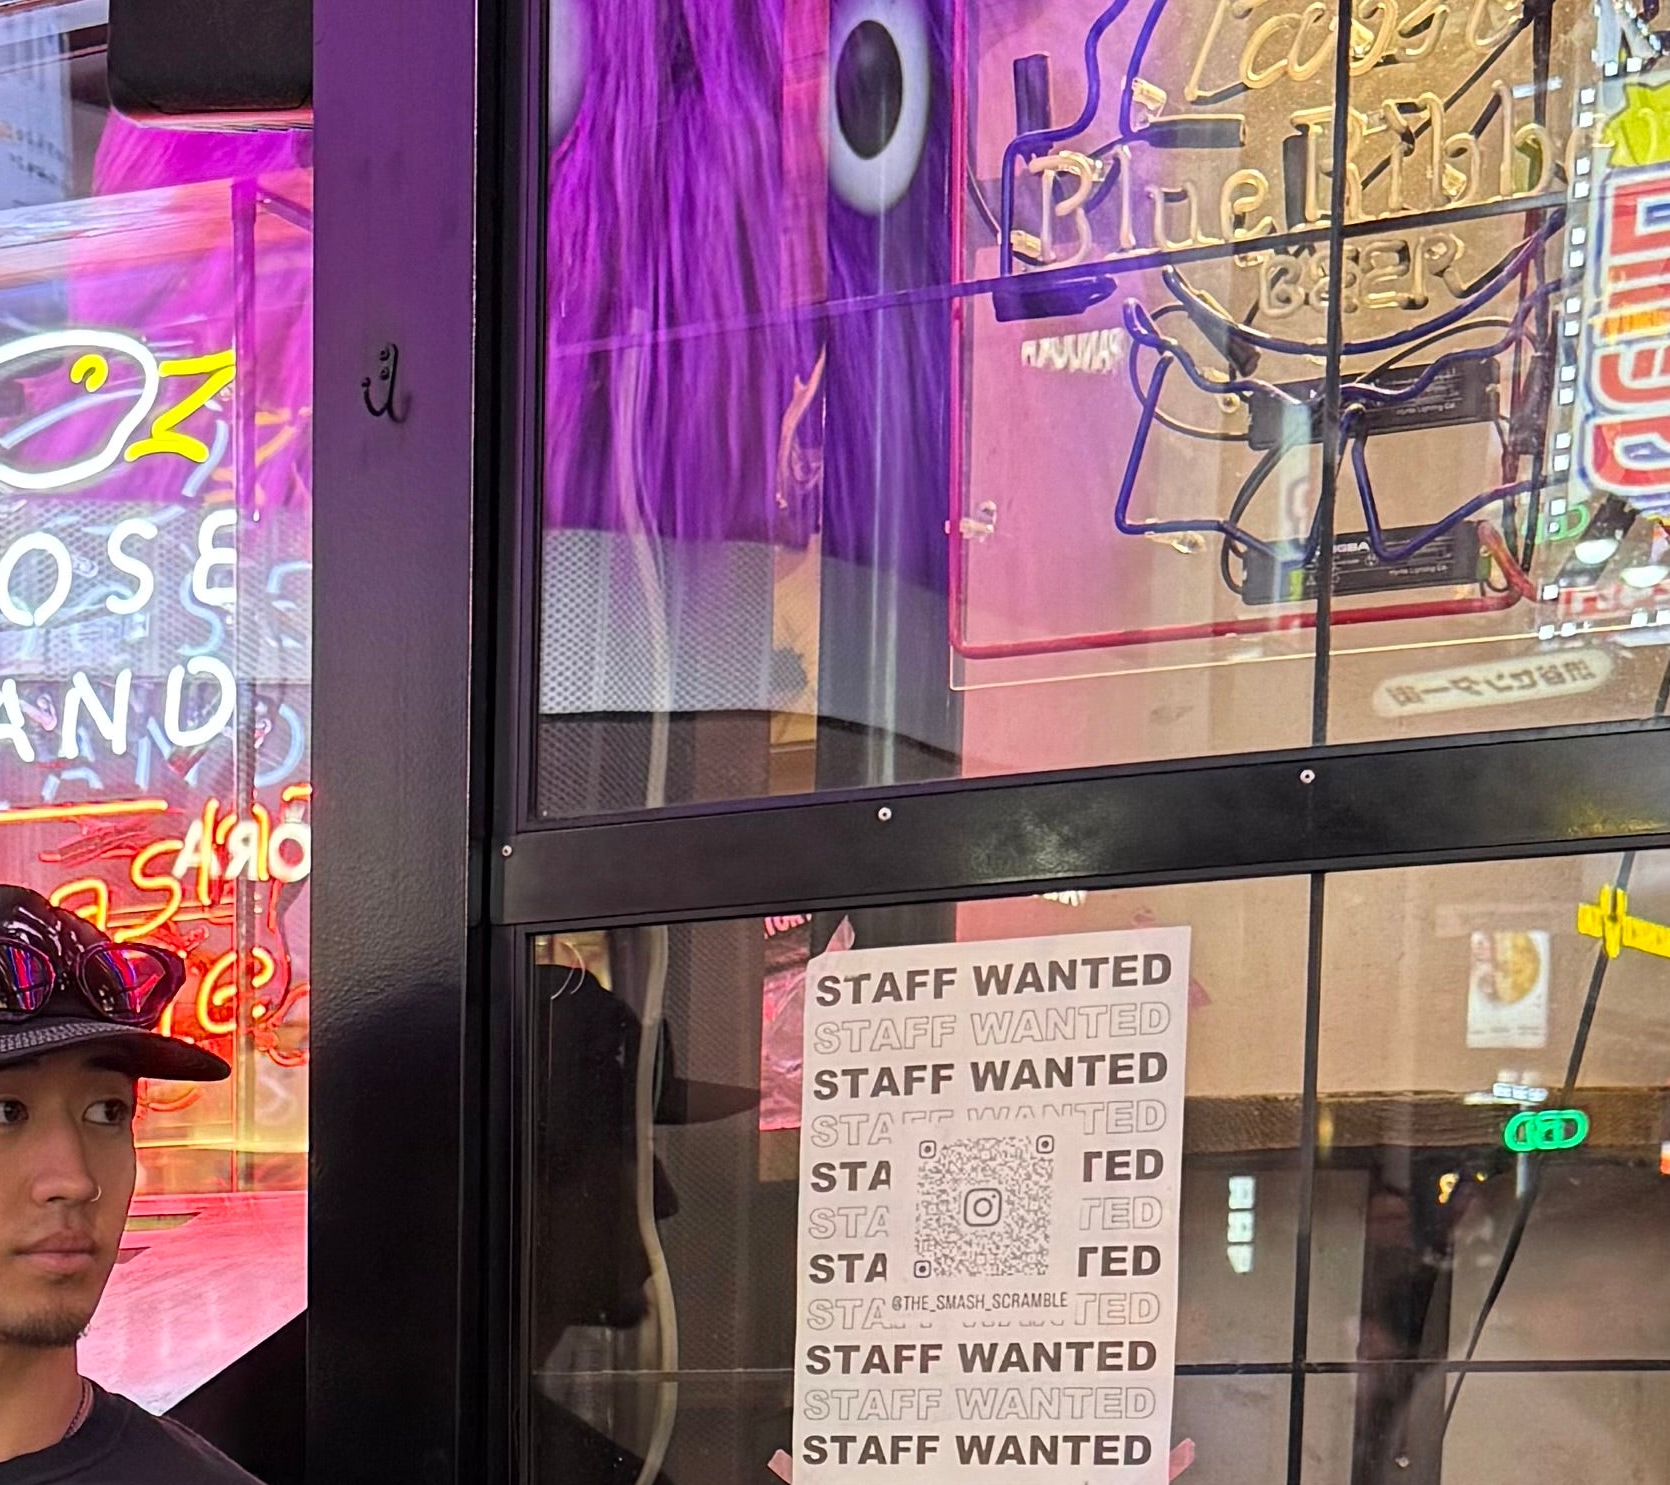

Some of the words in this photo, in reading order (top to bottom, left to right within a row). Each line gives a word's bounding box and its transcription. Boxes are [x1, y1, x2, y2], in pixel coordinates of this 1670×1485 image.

[816, 967, 957, 1007] STAFF
[973, 953, 1172, 997] WANTED
[813, 1015, 957, 1054] STAFF
[970, 1002, 1171, 1046] WANTED
[813, 1063, 955, 1100] STAFF
[970, 1052, 1168, 1092] WANTED
[810, 1160, 891, 1193] STA
[1083, 1149, 1164, 1183] TED
[809, 1206, 889, 1239] STA
[1080, 1196, 1163, 1231] TED
[809, 1252, 887, 1284] STA
[1078, 1245, 1161, 1279] TED
[892, 1292, 1068, 1313] @THE_SMASH_SCRAMBLE
[805, 1344, 943, 1375] STAFF
[958, 1340, 1157, 1373] WANTED
[803, 1389, 942, 1421] STAFF
[955, 1387, 1156, 1419] WANTED
[802, 1435, 939, 1465] STAFF
[955, 1435, 1152, 1466] WANTED
